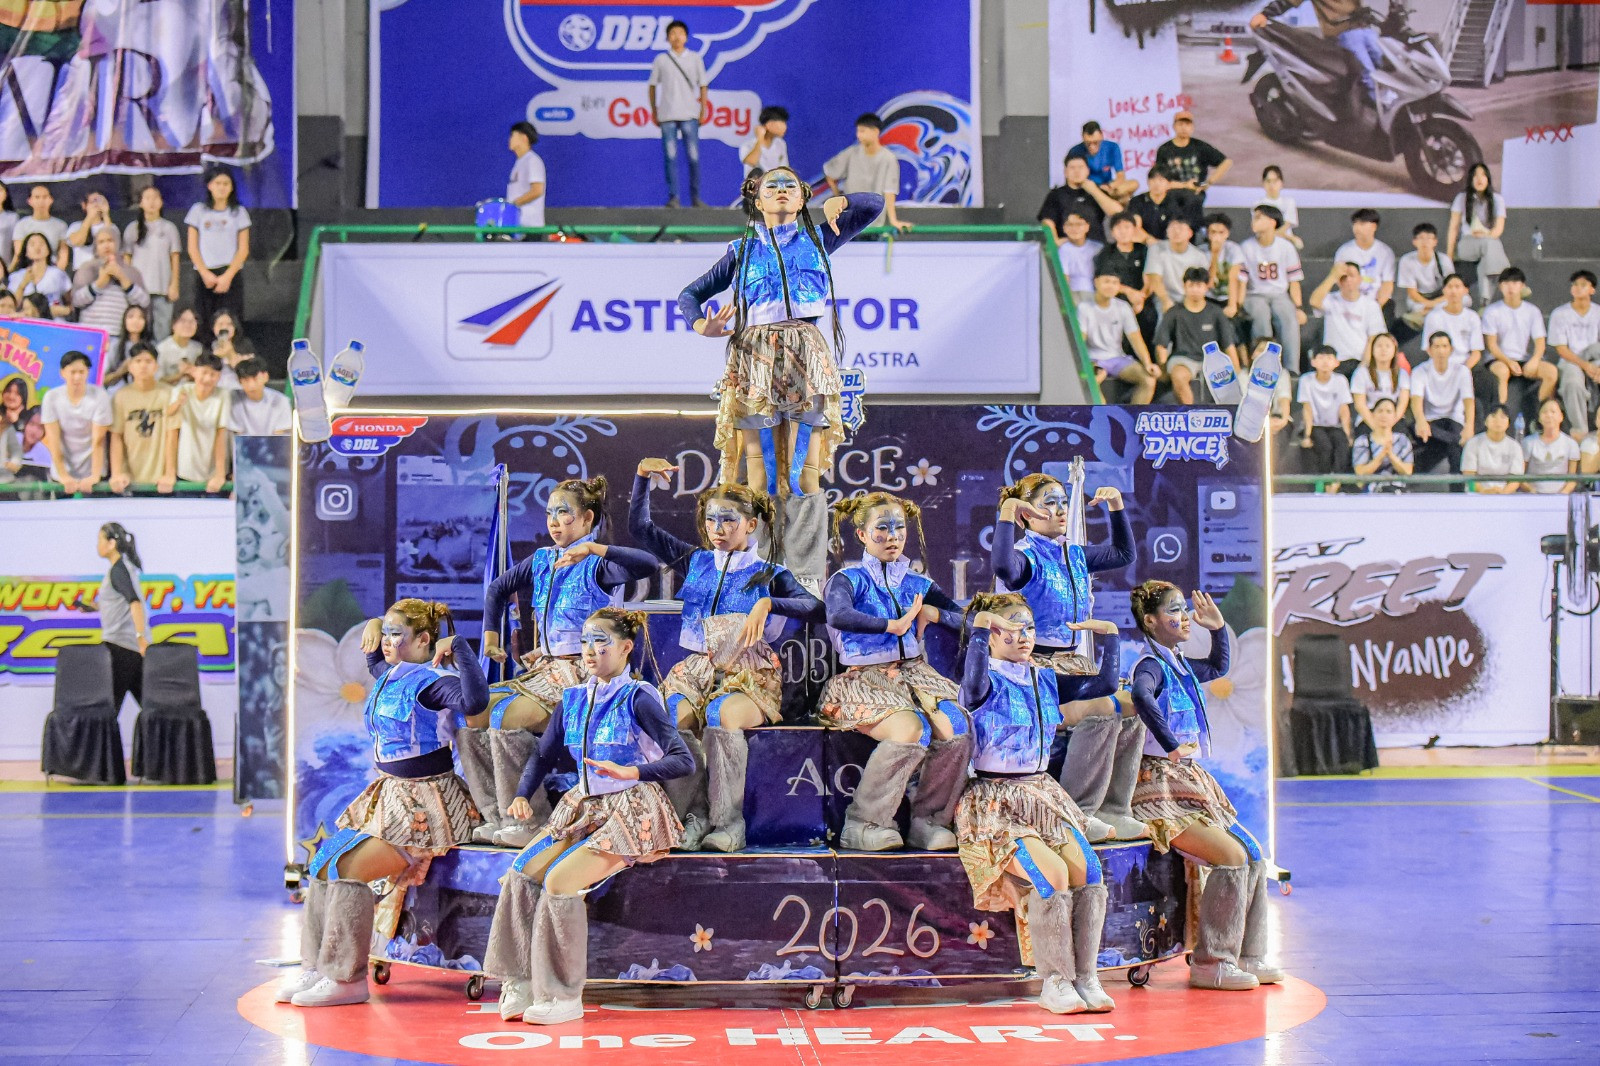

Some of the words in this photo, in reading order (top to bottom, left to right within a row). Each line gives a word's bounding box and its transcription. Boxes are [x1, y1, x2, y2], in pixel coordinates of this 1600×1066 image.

[596, 15, 674, 50] DBL
[1258, 262, 1278, 280] 98
[853, 352, 919, 368] ASTRA
[1213, 369, 1231, 382] AQUA
[1256, 370, 1273, 382] AQUA
[354, 424, 406, 432] HONDA
[1137, 412, 1188, 434] AQUA
[1202, 416, 1230, 428] DBL
[353, 438, 380, 451] DBL
[1145, 436, 1220, 468] DANCE
[773, 894, 941, 962] 2026
[458, 1031, 697, 1050] One
[725, 1023, 1140, 1047] HEART.
